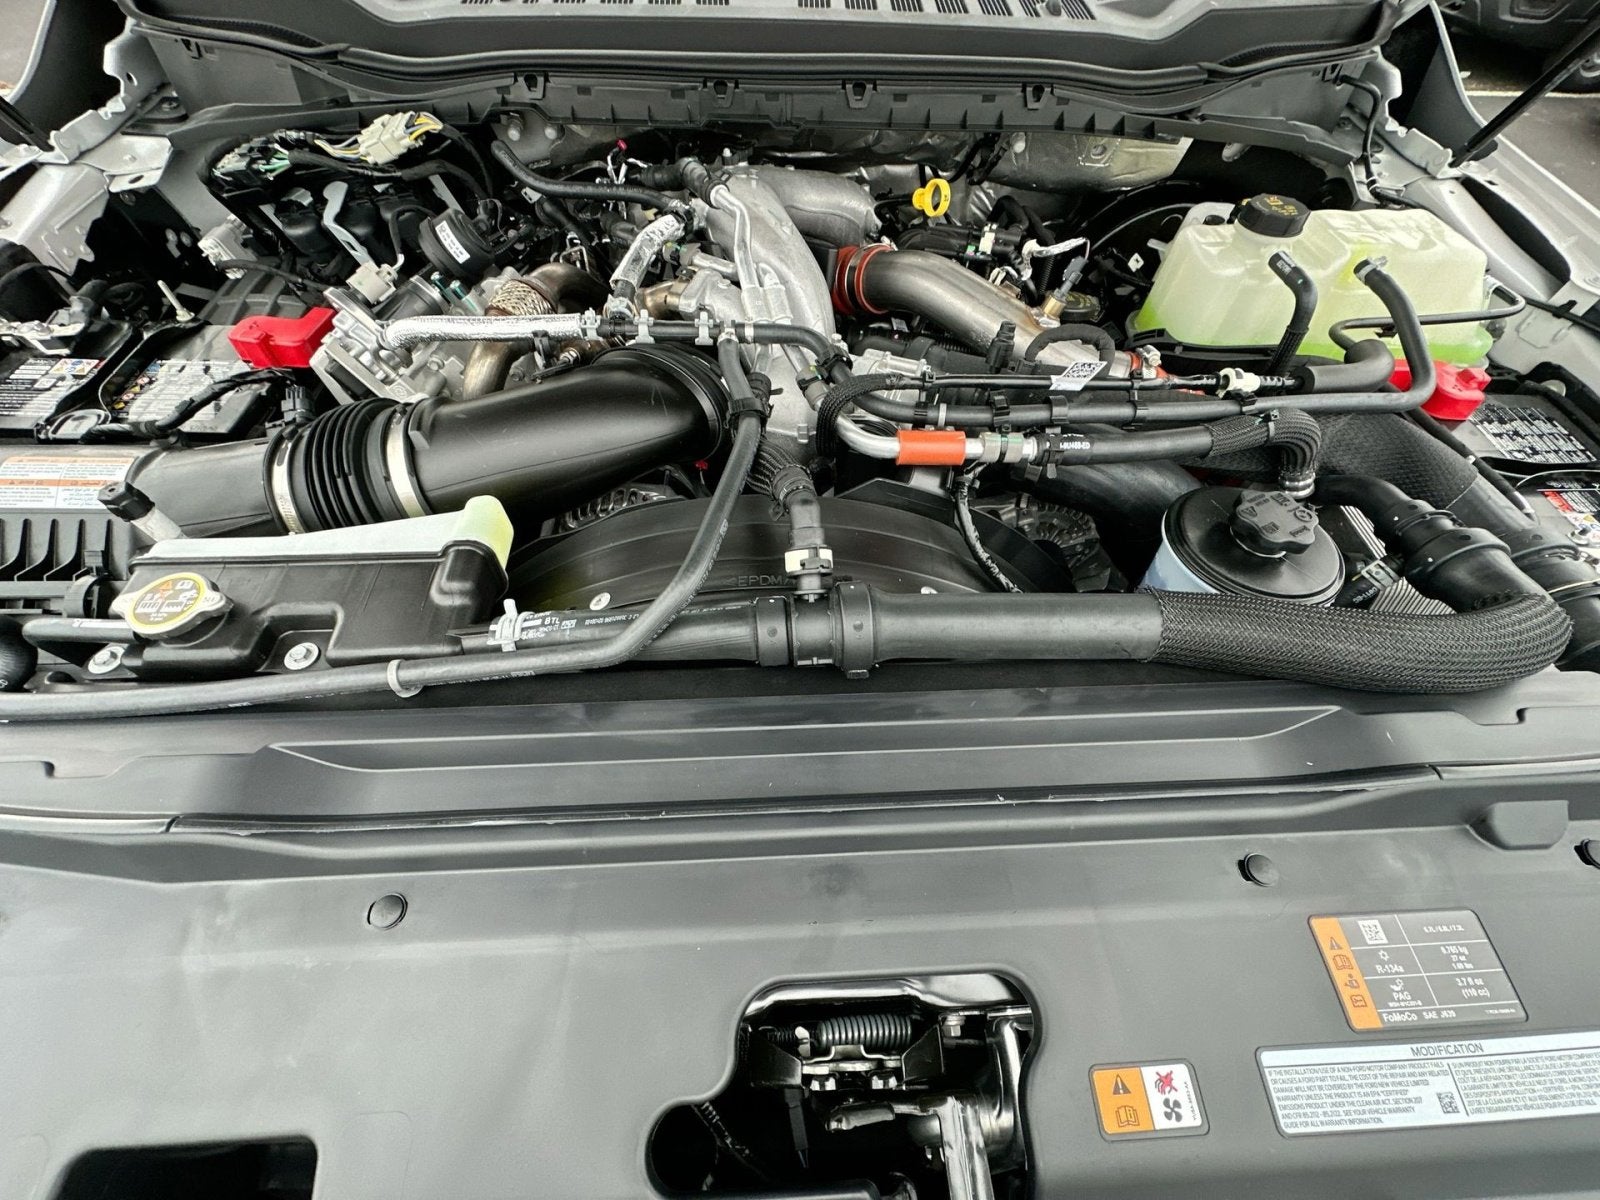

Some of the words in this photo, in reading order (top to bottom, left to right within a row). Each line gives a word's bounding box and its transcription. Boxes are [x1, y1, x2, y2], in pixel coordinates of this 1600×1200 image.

[1375, 964, 1404, 974] R-134a
[1392, 991, 1412, 1001] PAG
[1382, 1011, 1418, 1022] FoMoCo
[1422, 1011, 1439, 1020] SAE
[1410, 1043, 1484, 1056] MODIFICATION
